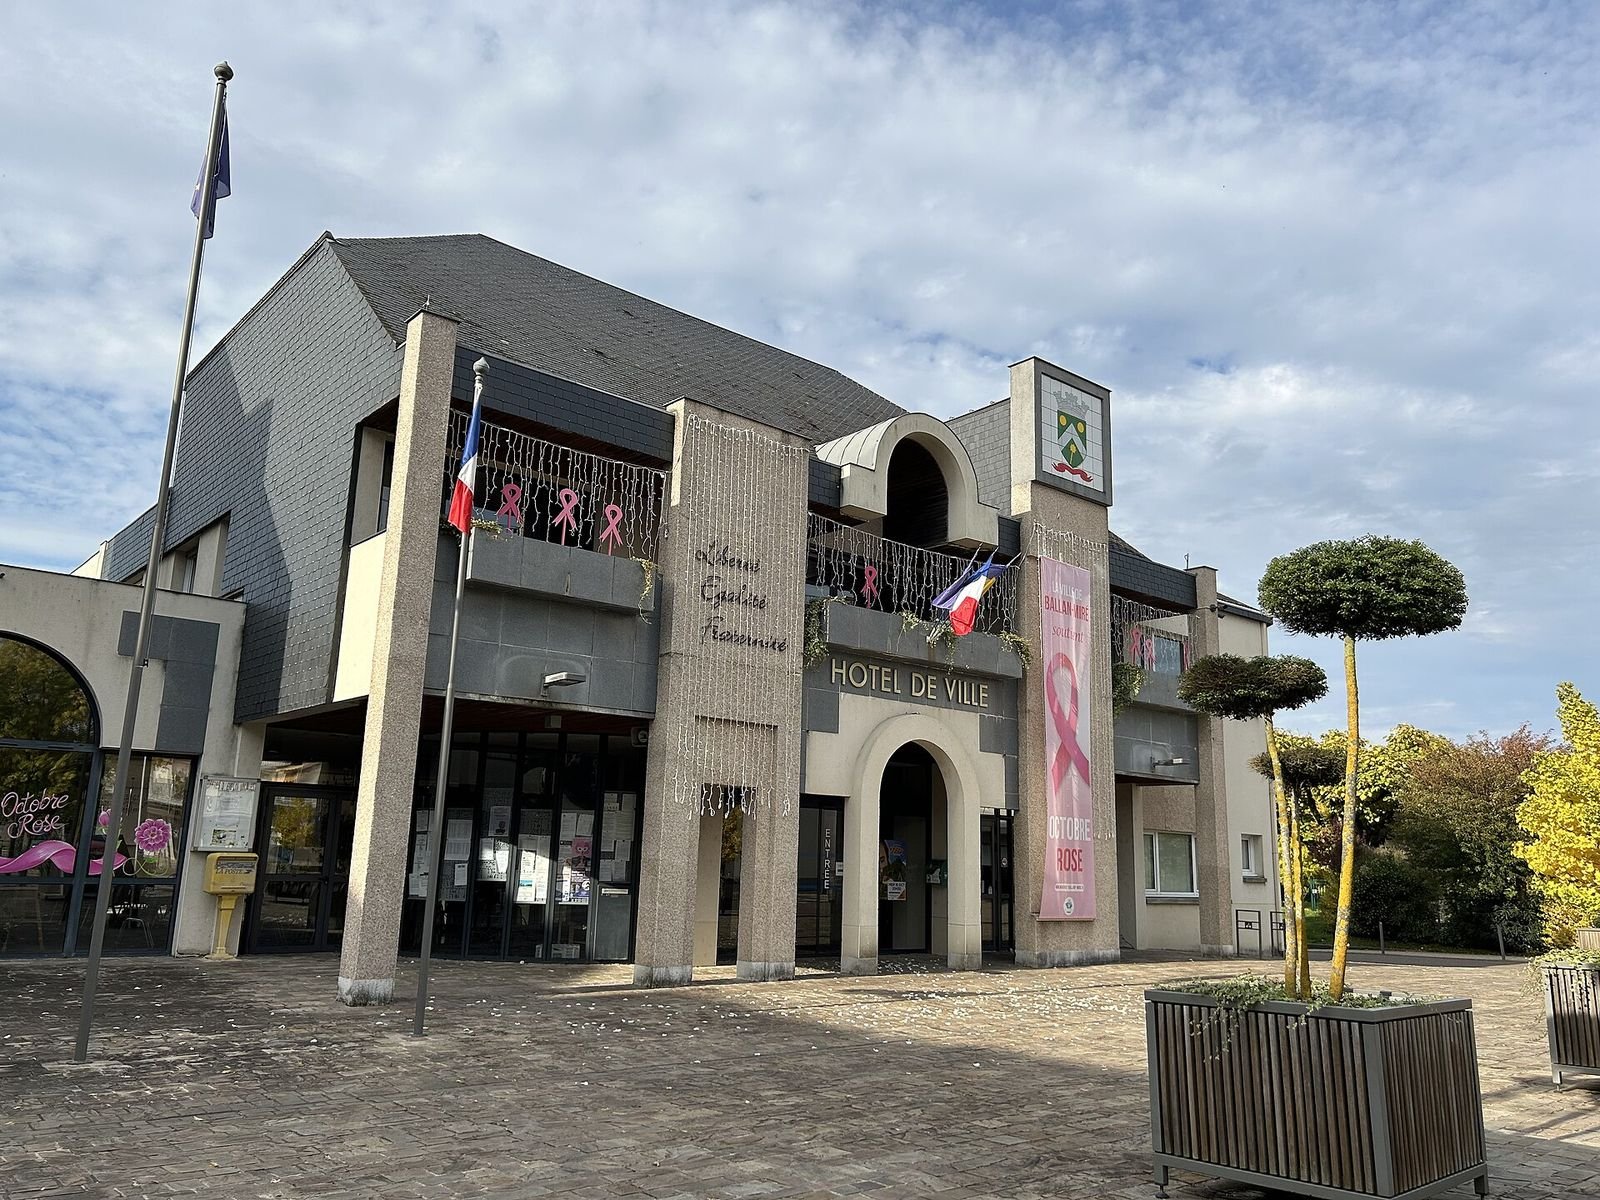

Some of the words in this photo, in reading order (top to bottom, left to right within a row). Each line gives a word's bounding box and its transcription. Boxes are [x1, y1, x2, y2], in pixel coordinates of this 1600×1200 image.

[831, 658, 901, 694] HOTEL
[911, 672, 937, 699] DE
[944, 677, 989, 708] VILLE
[1, 788, 69, 817] Octobre
[7, 813, 69, 839] Rose
[1049, 815, 1092, 841] OCTOBRE
[1055, 848, 1083, 872] ROSE
